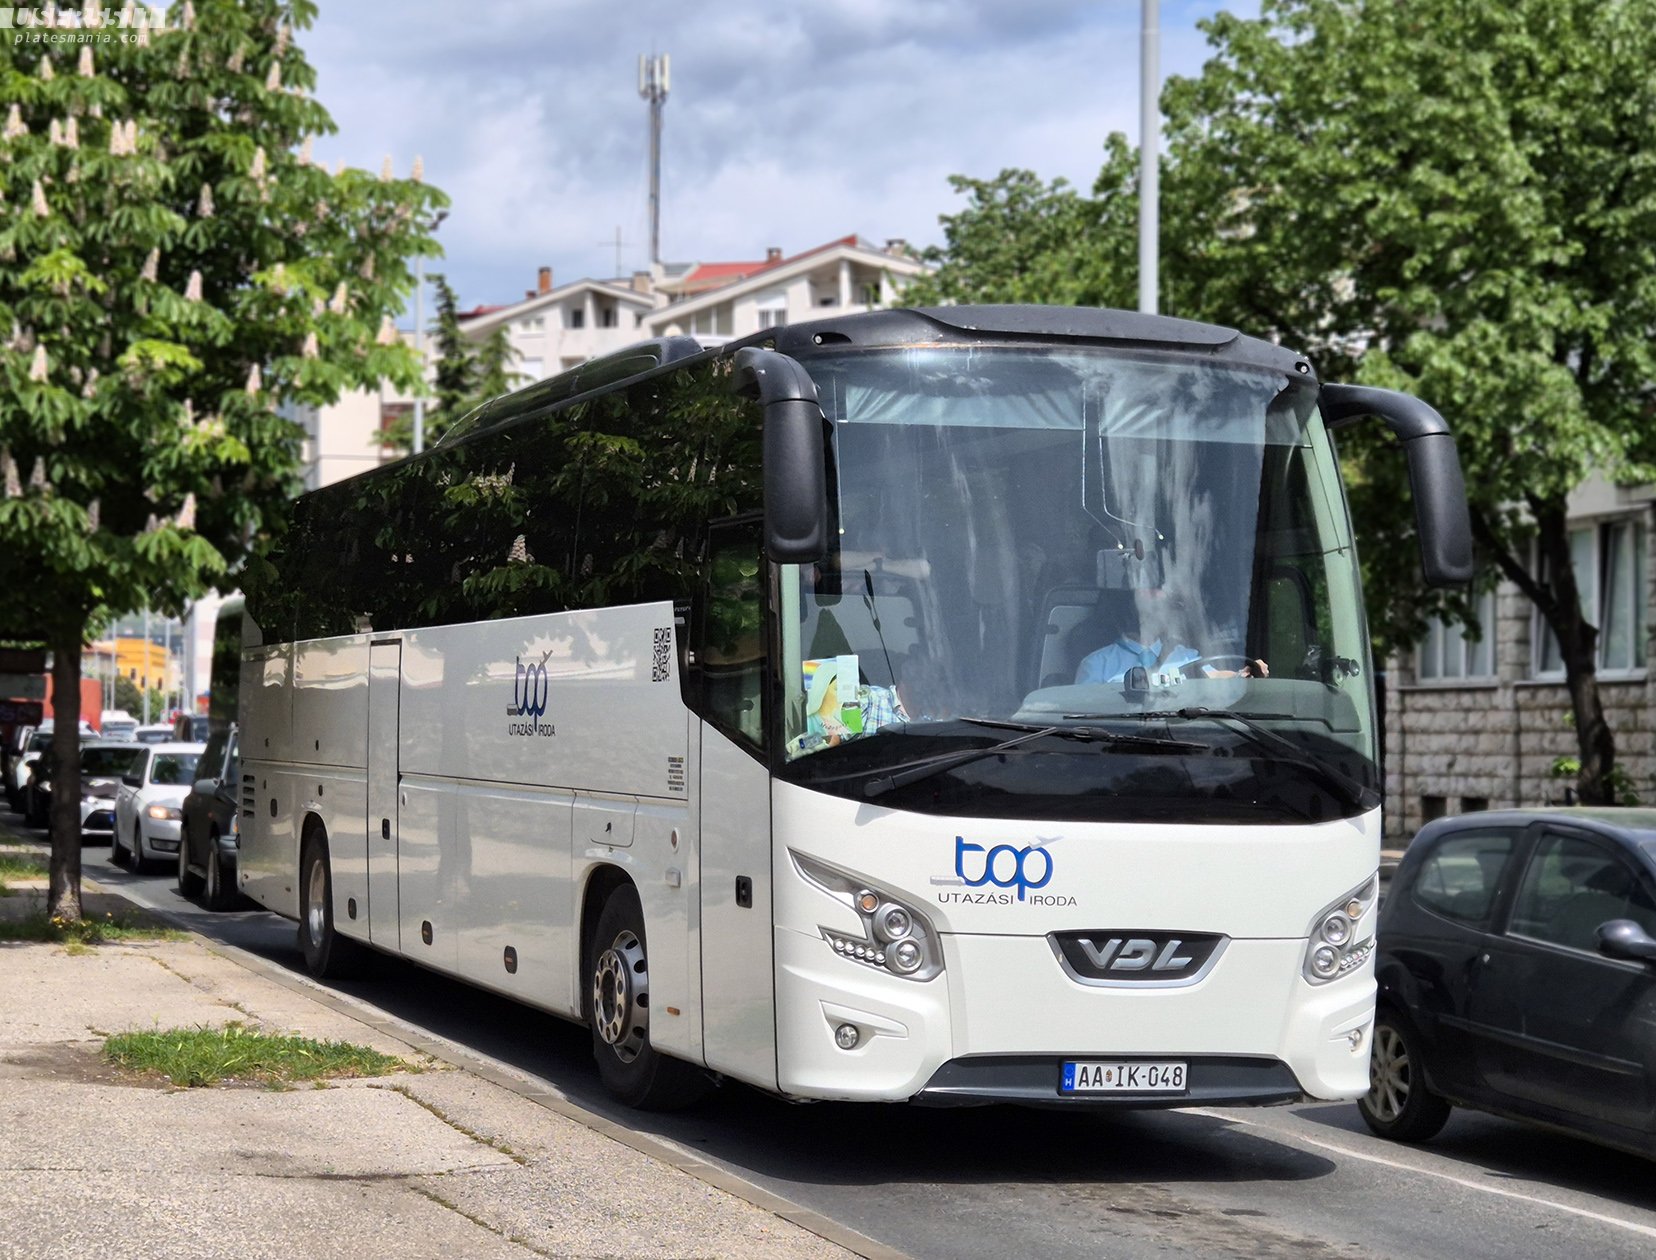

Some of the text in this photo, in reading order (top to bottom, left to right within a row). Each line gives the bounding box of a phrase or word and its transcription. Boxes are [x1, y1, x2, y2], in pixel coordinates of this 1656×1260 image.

[514, 655, 548, 733] top
[508, 721, 556, 737] UTAZÁSI IRODA
[955, 836, 1053, 901] top
[938, 891, 1078, 907] UTAZÁSI IRODA
[1077, 938, 1194, 971] VDL
[1115, 1065, 1184, 1088] IK-048
